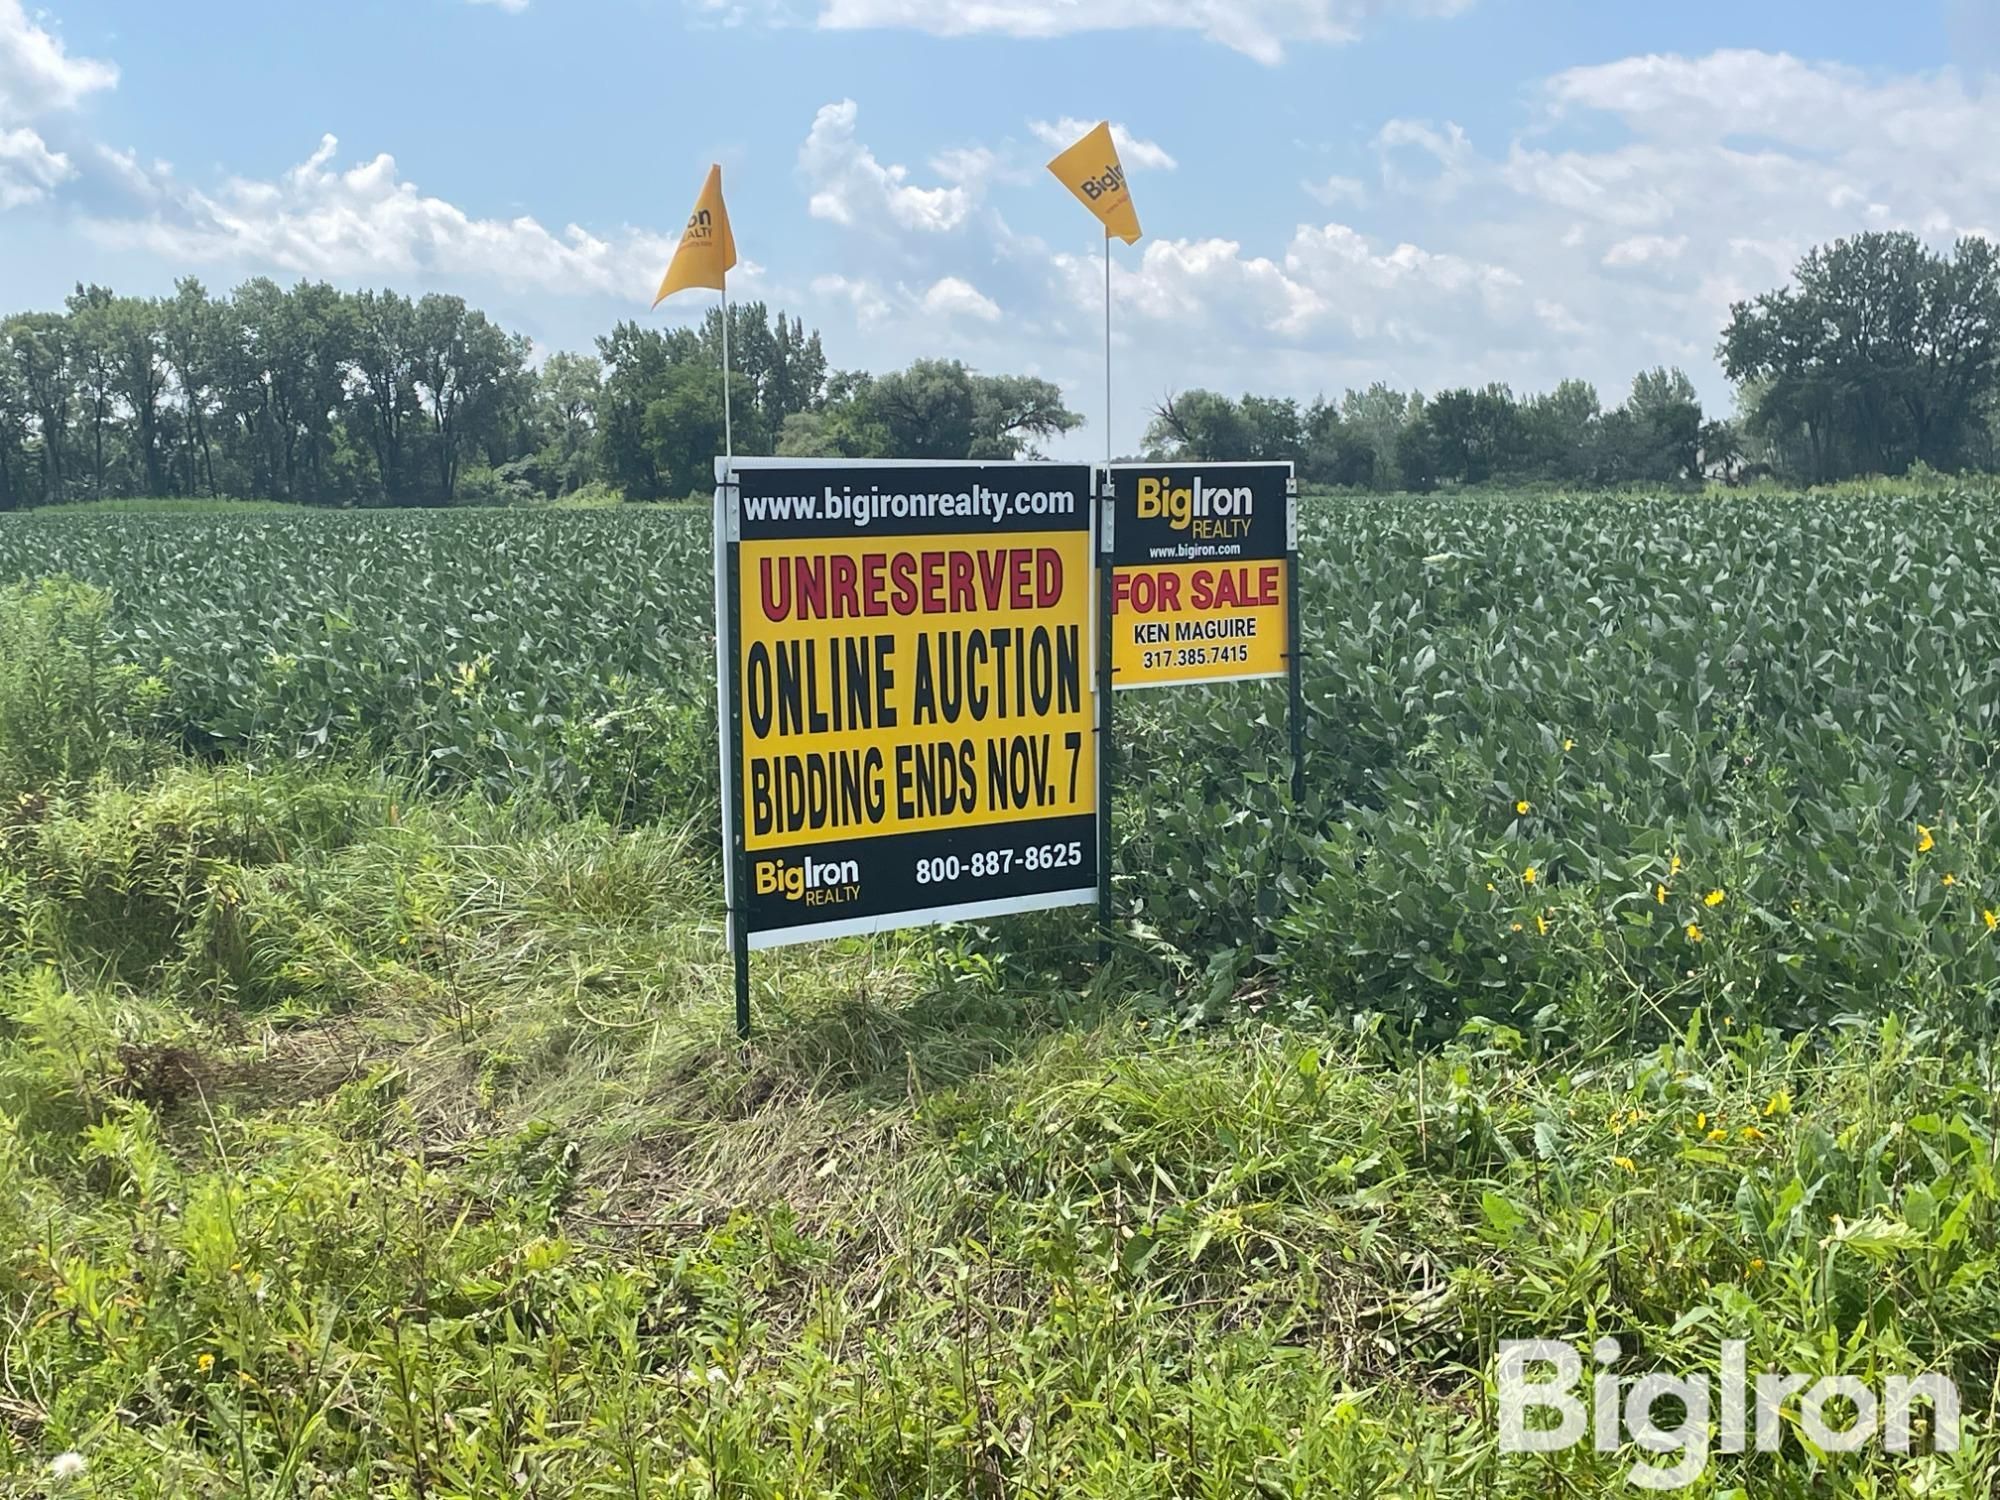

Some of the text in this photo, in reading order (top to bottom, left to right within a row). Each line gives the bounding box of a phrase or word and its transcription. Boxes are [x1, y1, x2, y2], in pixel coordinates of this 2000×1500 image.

[744, 484, 1075, 527] www.bigironrealty.com
[1137, 476, 1253, 531] BigIron
[1149, 543, 1241, 560] www.bigiron.com
[1192, 518, 1252, 540] REALTY
[760, 548, 1064, 623] UNRESERVED
[1112, 567, 1279, 615] FOR SALE
[1134, 618, 1257, 645] KEN MAGUIRE
[1144, 645, 1248, 669] 317.385.7415
[747, 625, 1081, 740] ONLINE AUCTION
[751, 732, 1082, 836] BIDDING ENDS NOV. 7
[756, 841, 1082, 900] BigIron 800-887-8625
[805, 885, 861, 907] REALTY
